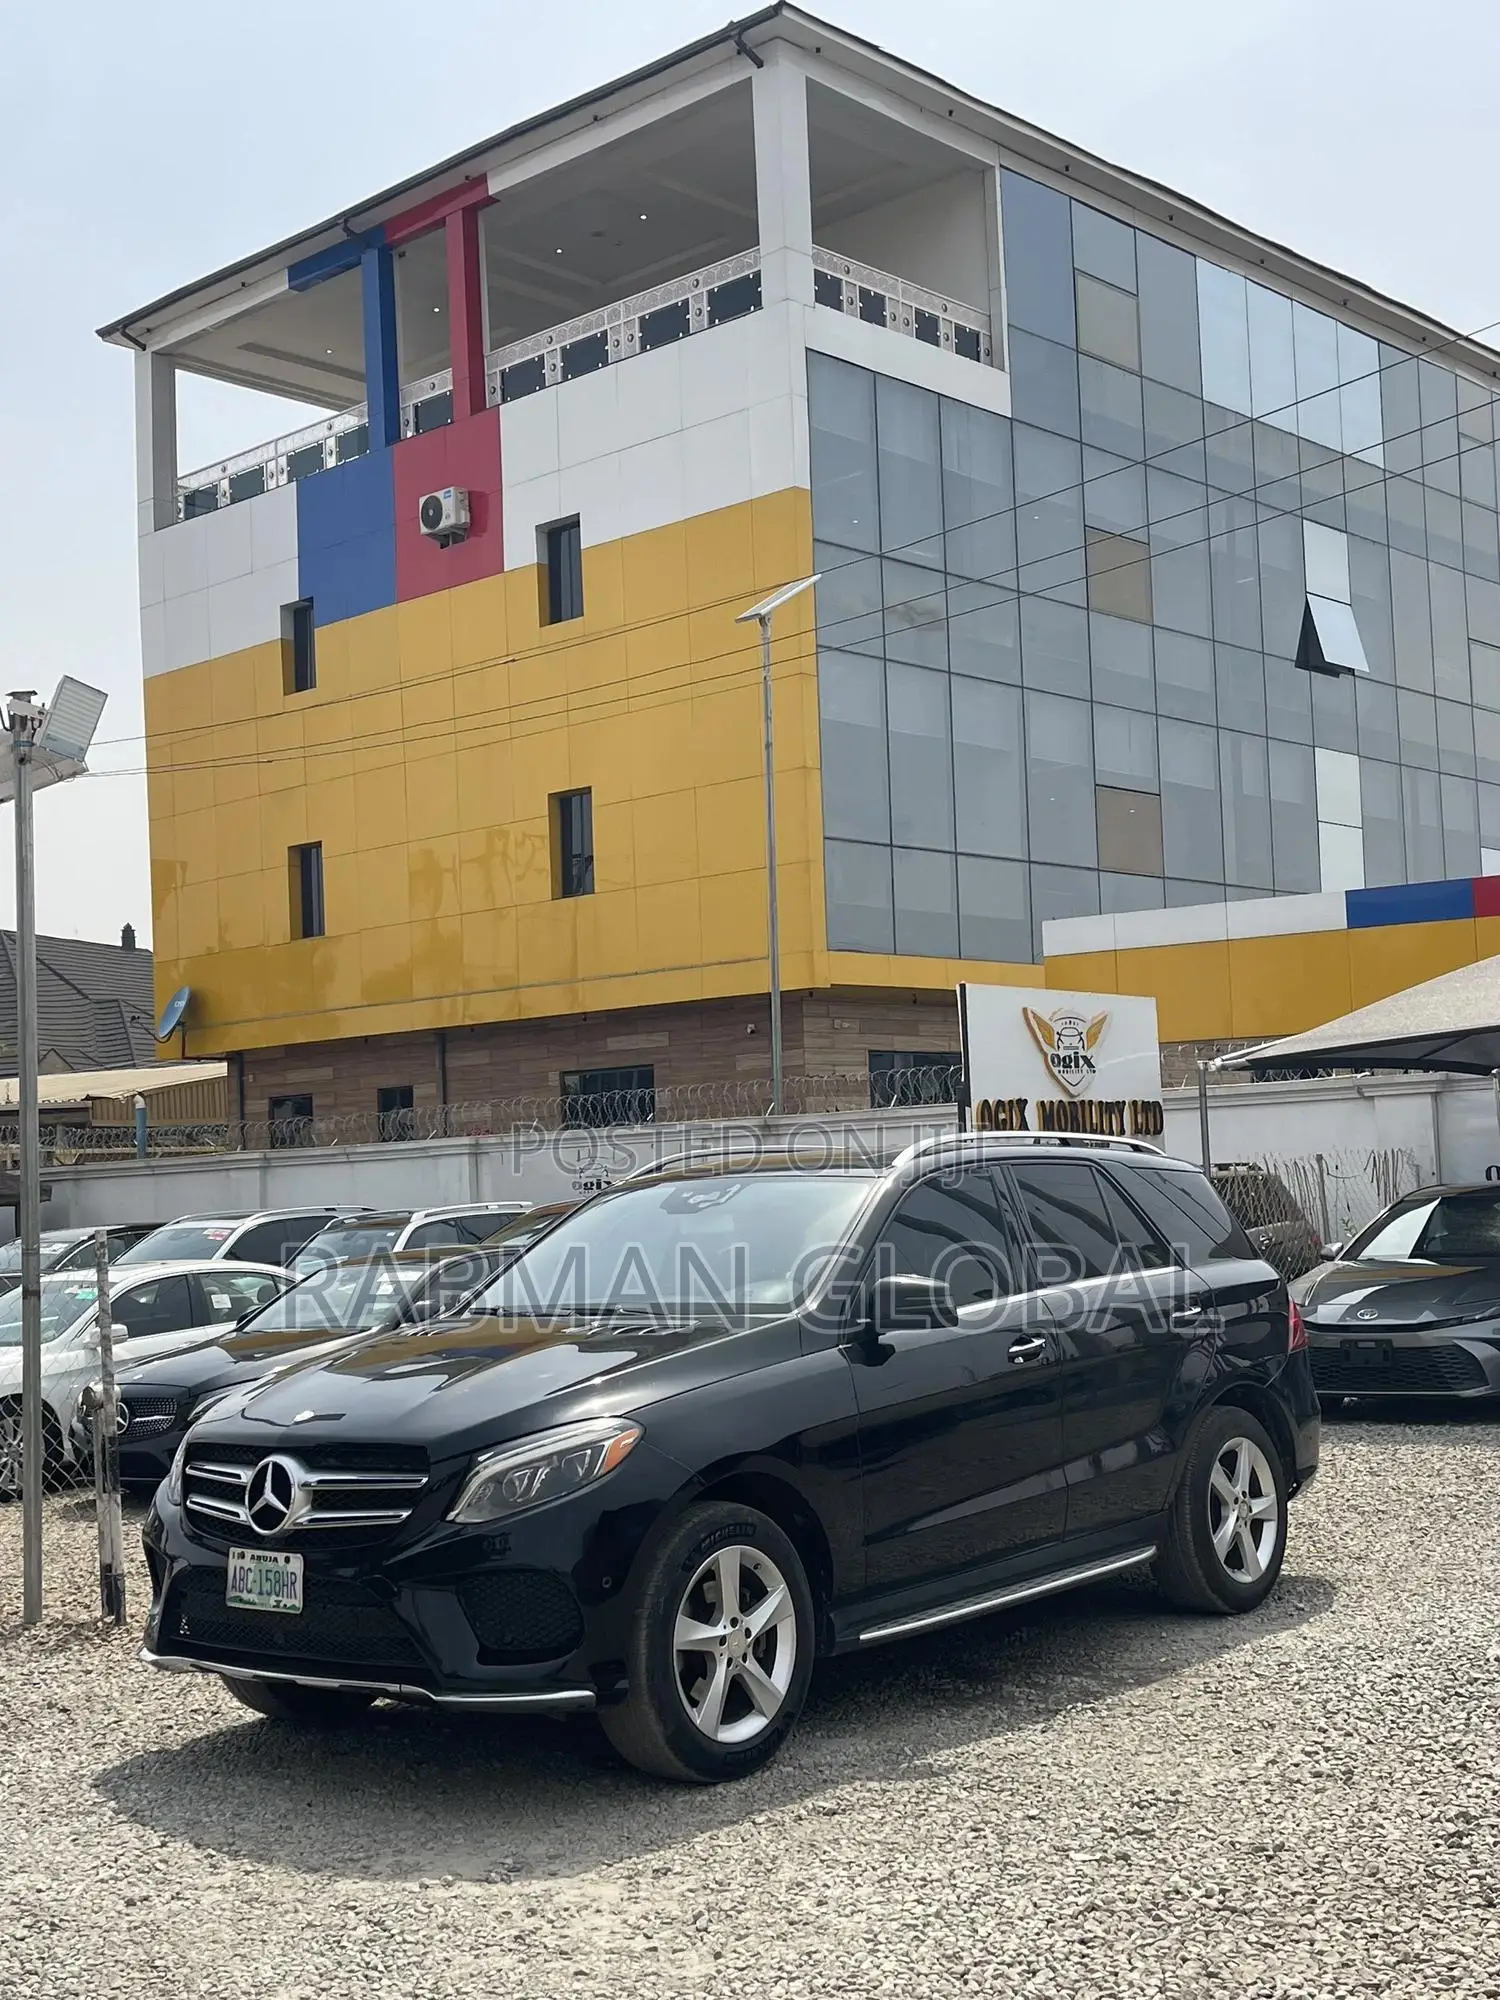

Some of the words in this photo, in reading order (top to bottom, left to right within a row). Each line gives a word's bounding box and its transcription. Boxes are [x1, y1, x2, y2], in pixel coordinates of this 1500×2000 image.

[976, 1098, 1031, 1131] OGIX
[1035, 1099, 1127, 1136] MOBILITY
[1128, 1099, 1164, 1136] LTD
[231, 1565, 298, 1600] ABC-158HR
